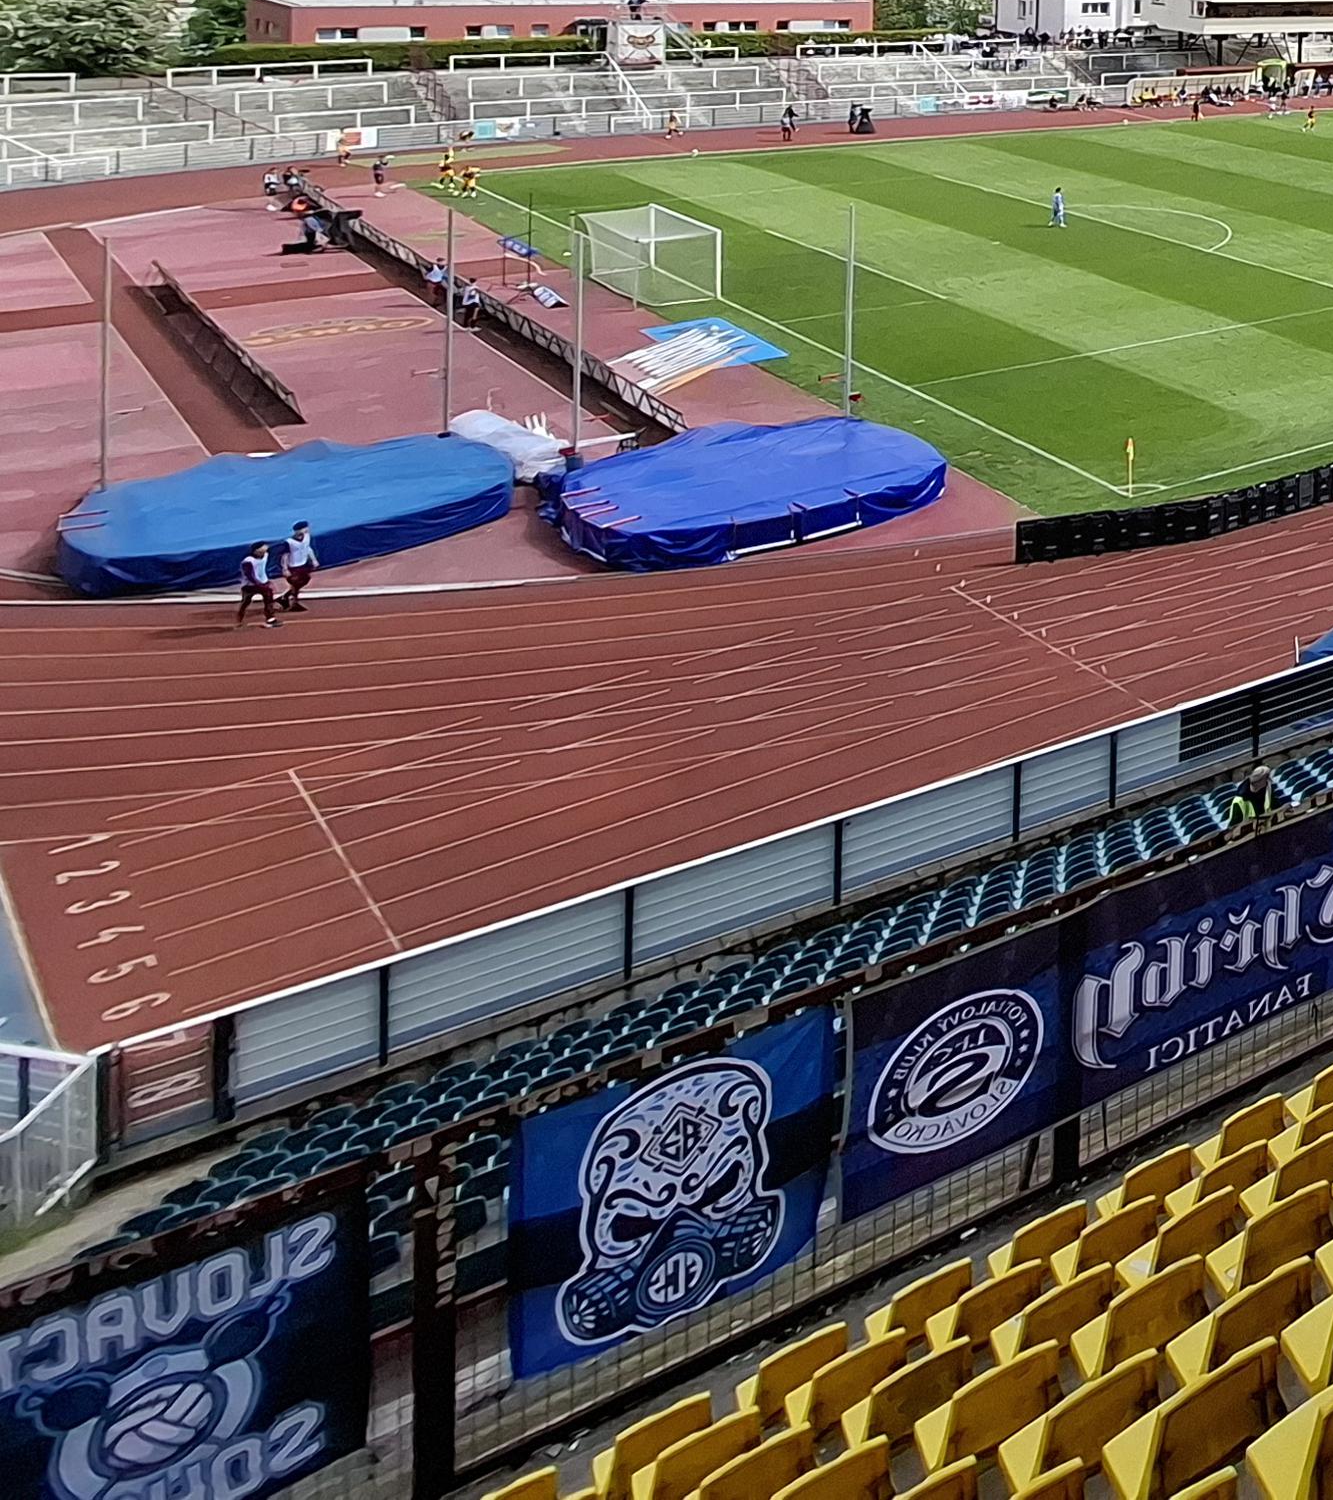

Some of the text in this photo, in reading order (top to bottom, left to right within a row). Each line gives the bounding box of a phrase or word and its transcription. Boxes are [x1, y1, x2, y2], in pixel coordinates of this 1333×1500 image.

[55, 860, 121, 885] 2
[63, 890, 132, 914] 3
[76, 925, 145, 950] 4
[86, 953, 158, 984] 5
[101, 992, 172, 1022] 6
